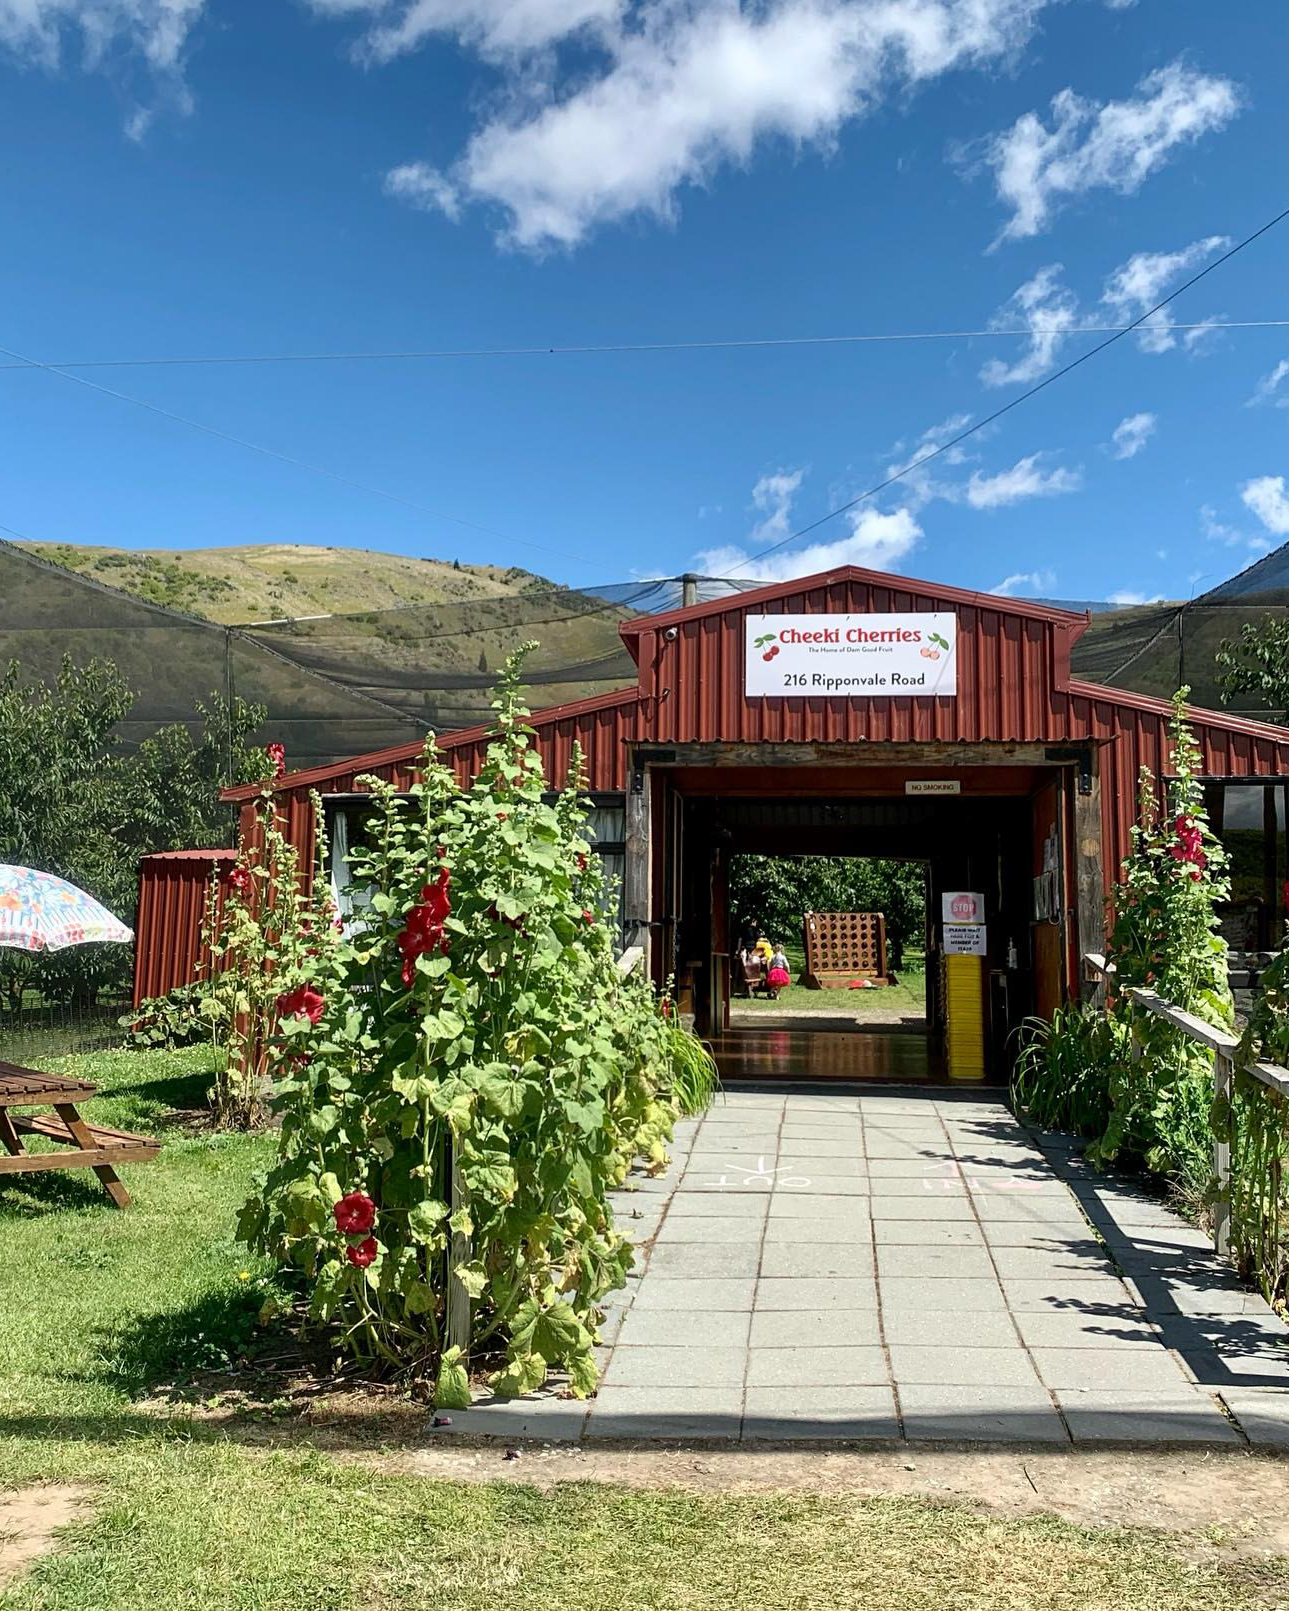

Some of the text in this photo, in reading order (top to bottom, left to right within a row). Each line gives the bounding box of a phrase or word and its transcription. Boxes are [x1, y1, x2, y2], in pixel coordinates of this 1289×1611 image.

[779, 627, 922, 644] Cheeki Cherries
[783, 672, 925, 691] 216 Ripponvale Road
[923, 783, 955, 791] SMOKING
[952, 903, 975, 912] STOP
